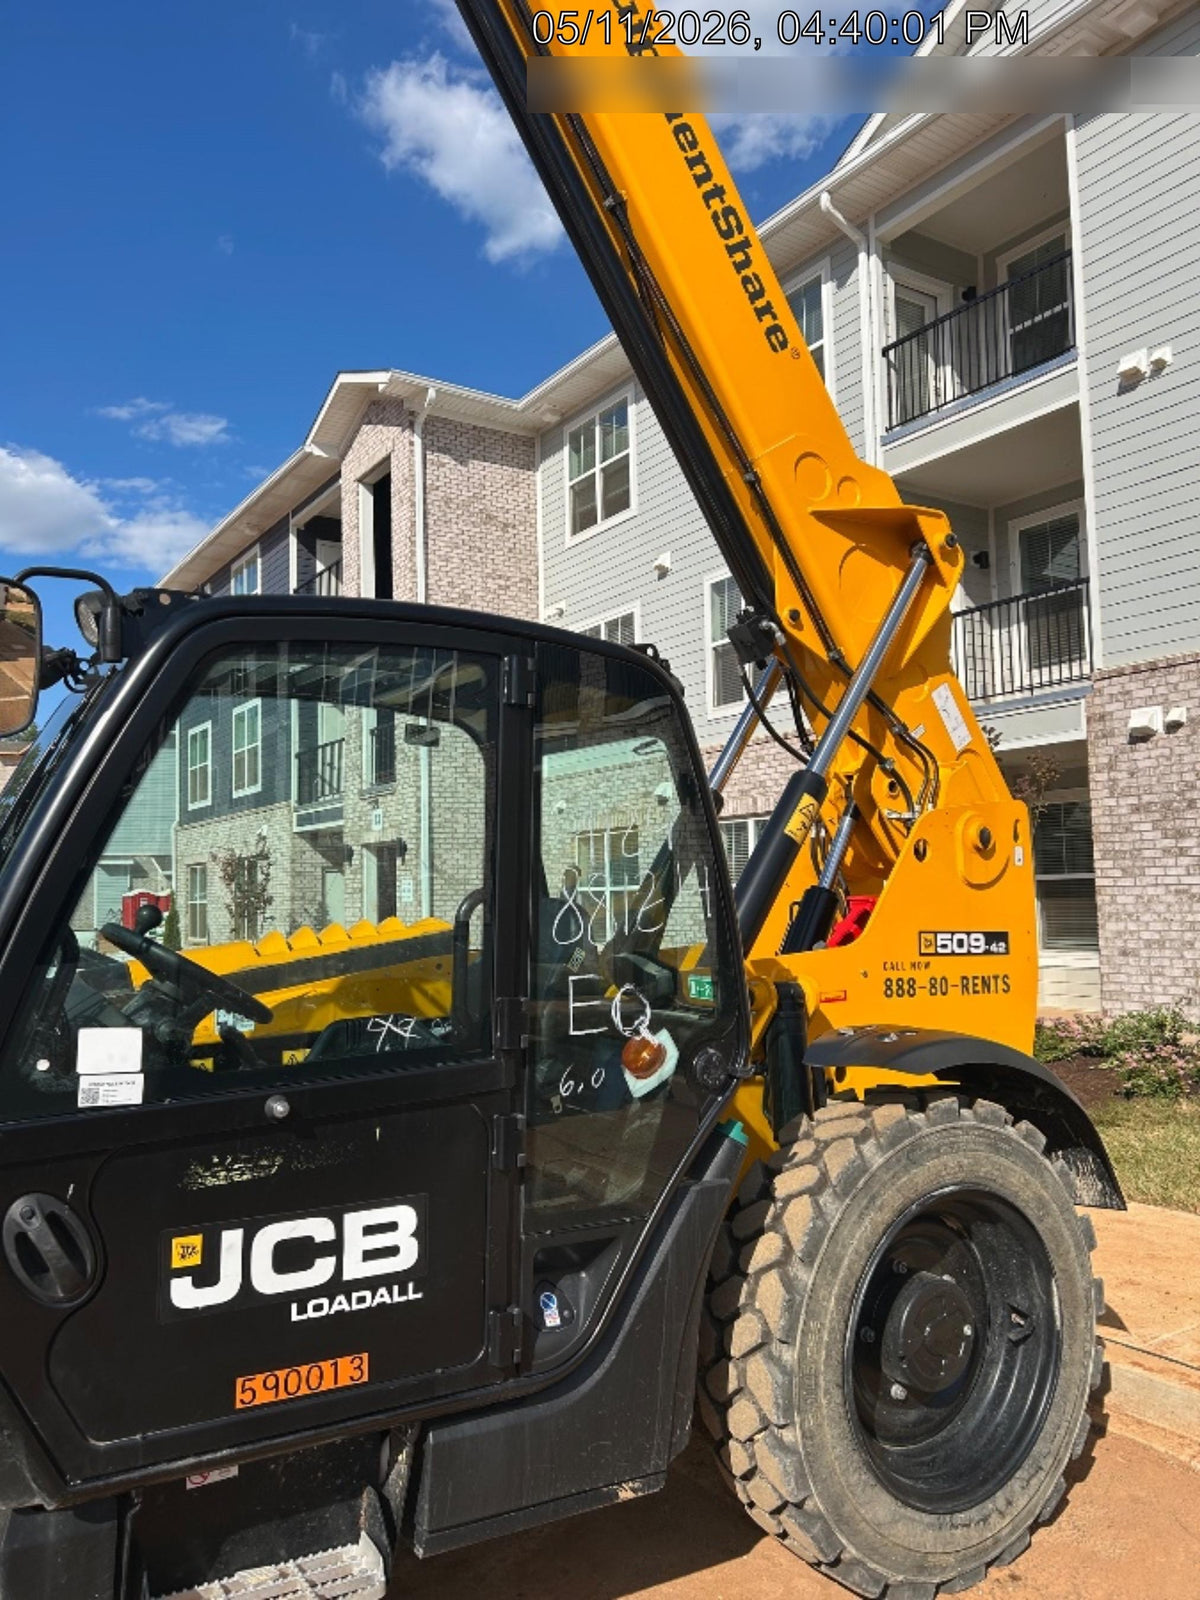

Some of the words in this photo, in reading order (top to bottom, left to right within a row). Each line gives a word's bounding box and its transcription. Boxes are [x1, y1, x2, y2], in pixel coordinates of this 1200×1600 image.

[883, 961, 906, 971] CALL
[910, 961, 931, 971] NOW
[883, 974, 1011, 998] 888-80-RENTS
[170, 1204, 419, 1309] JCB
[291, 1282, 423, 1321] LOADALL
[239, 1355, 364, 1405] 590013
